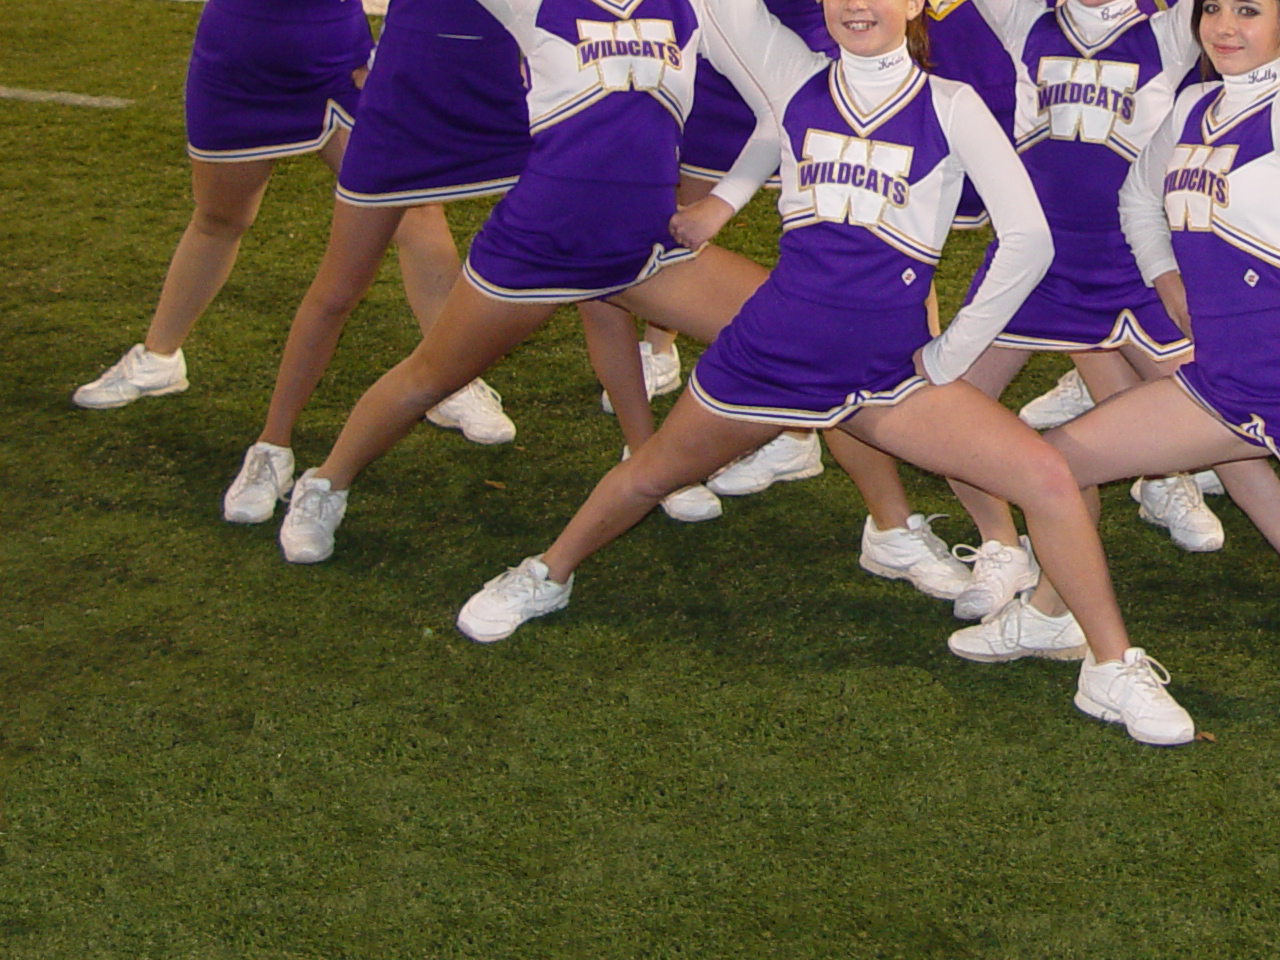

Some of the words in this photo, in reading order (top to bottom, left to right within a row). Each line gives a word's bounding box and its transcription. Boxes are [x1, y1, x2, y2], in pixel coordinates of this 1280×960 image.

[580, 39, 680, 67] WILDCATS
[1037, 82, 1134, 121] WILDCATS
[799, 160, 907, 206] WILDCATS
